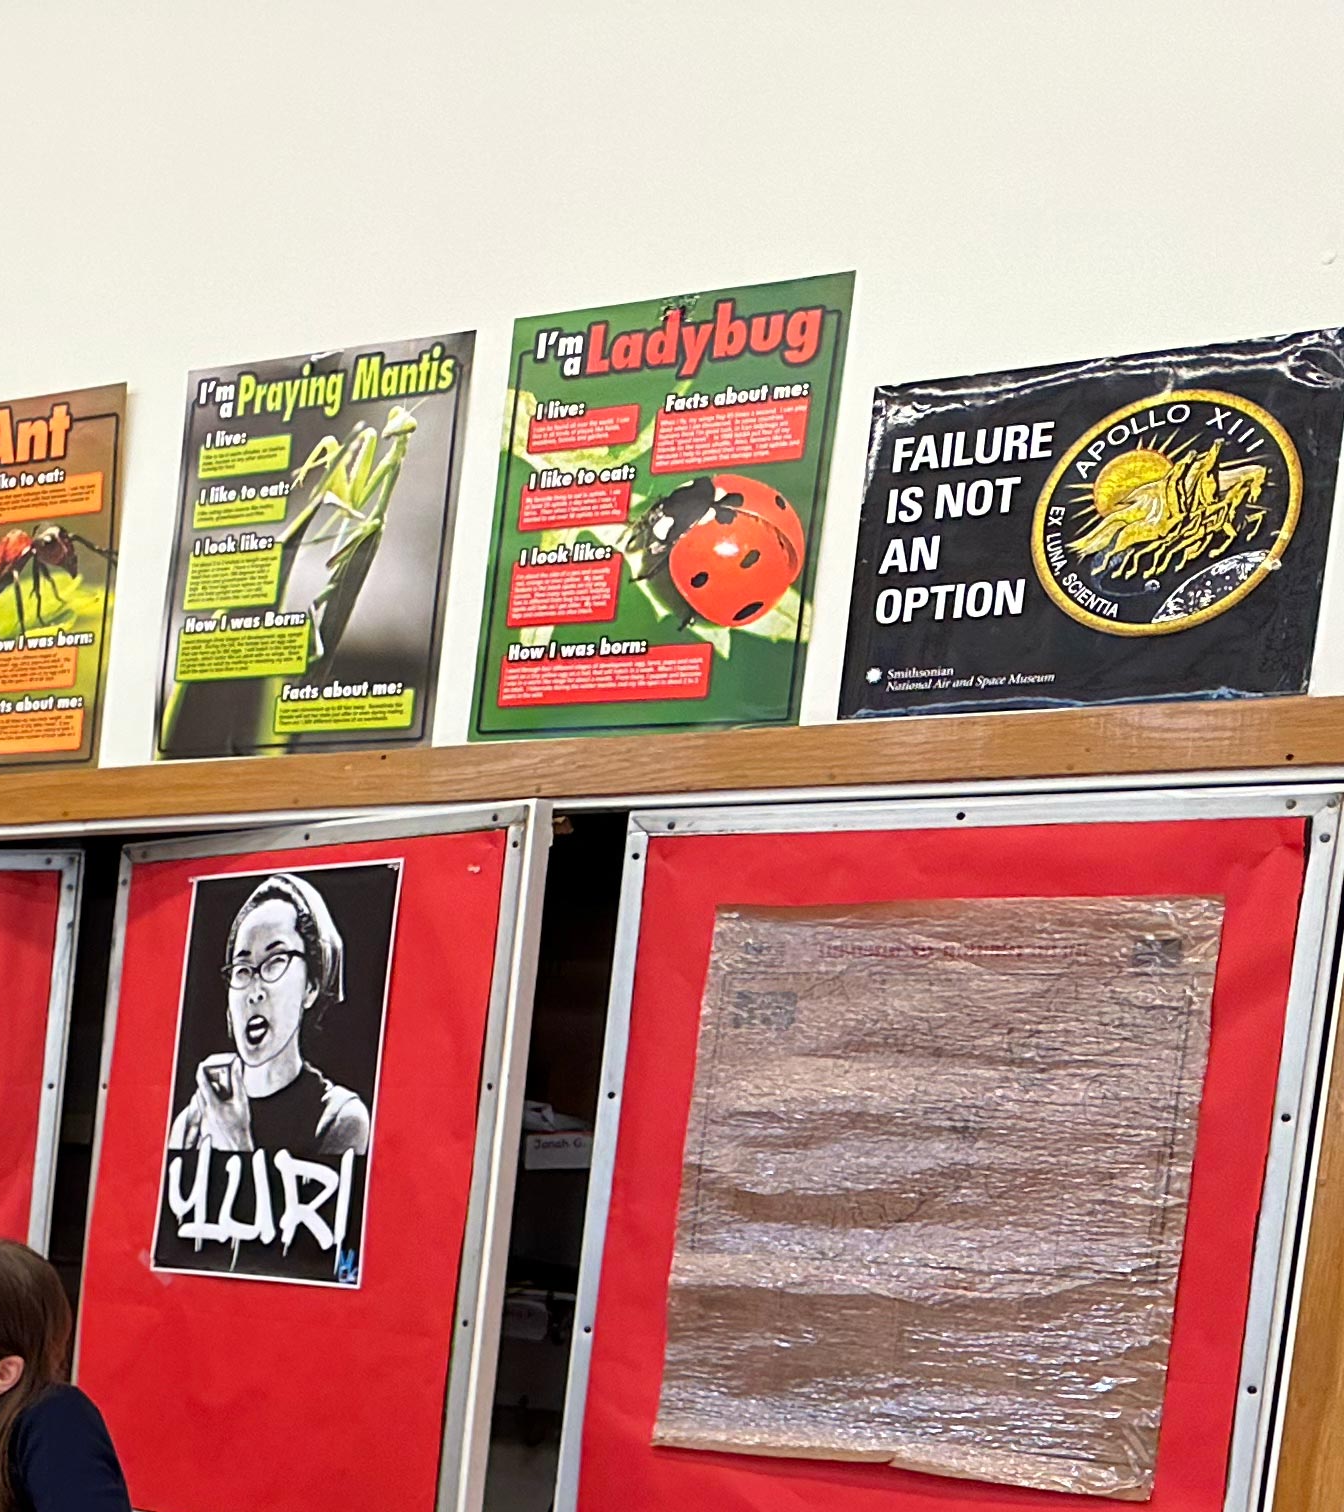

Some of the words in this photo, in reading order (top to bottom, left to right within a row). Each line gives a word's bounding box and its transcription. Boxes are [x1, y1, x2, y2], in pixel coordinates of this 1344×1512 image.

[537, 331, 584, 359] I'm
[563, 357, 582, 377] a
[585, 301, 822, 378] Ladybug
[199, 380, 235, 405] I'm
[220, 402, 233, 419] a
[236, 363, 345, 422] Praying
[352, 345, 456, 402] Mantis
[536, 403, 545, 420] I
[546, 399, 585, 418] live:
[664, 394, 709, 413] Facts
[713, 385, 770, 407] about
[773, 382, 810, 400] me:
[206, 433, 212, 448] I
[215, 430, 247, 446] live:
[891, 421, 1055, 474] FAILURE
[1075, 403, 1191, 479] APOLLO
[1205, 407, 1265, 453] XIII
[20, 472, 34, 486] to
[37, 468, 64, 485] eat:
[529, 473, 537, 490] I
[540, 470, 573, 488] like
[577, 469, 595, 484] to
[599, 466, 636, 482] eat:
[200, 490, 207, 505] I
[209, 485, 237, 503] like
[240, 484, 256, 499] to
[259, 481, 290, 497] eat:
[886, 485, 924, 525] IS
[934, 476, 1022, 520] NOT
[1047, 505, 1065, 526] EX
[194, 539, 202, 556] I
[204, 535, 236, 554] look
[240, 533, 273, 551] like:
[519, 550, 527, 567] I
[530, 546, 568, 565] look
[572, 543, 612, 561] like:
[878, 535, 941, 575] AN
[1046, 535, 1068, 576] LUNA,
[875, 578, 1026, 625] OPTION
[1062, 572, 1119, 619] SCIENTIA
[185, 617, 218, 633] How
[220, 616, 228, 631] I
[230, 616, 260, 630] was
[264, 612, 305, 628] Born:
[27, 635, 53, 649] was
[57, 630, 93, 646] born:
[508, 644, 545, 661] How
[548, 643, 556, 659] I
[559, 643, 595, 658] was
[599, 637, 647, 656] born:
[886, 665, 954, 680] Smithsonian
[886, 678, 931, 693] National
[933, 678, 950, 690] Air
[952, 676, 973, 688] and
[975, 675, 1006, 689] Space
[1007, 672, 1055, 686] Museum
[282, 683, 319, 701] Facts
[322, 680, 369, 699] about
[372, 683, 403, 696] me:
[16, 695, 54, 712] about
[57, 697, 83, 709] me:
[168, 1133, 354, 1258] YURI
